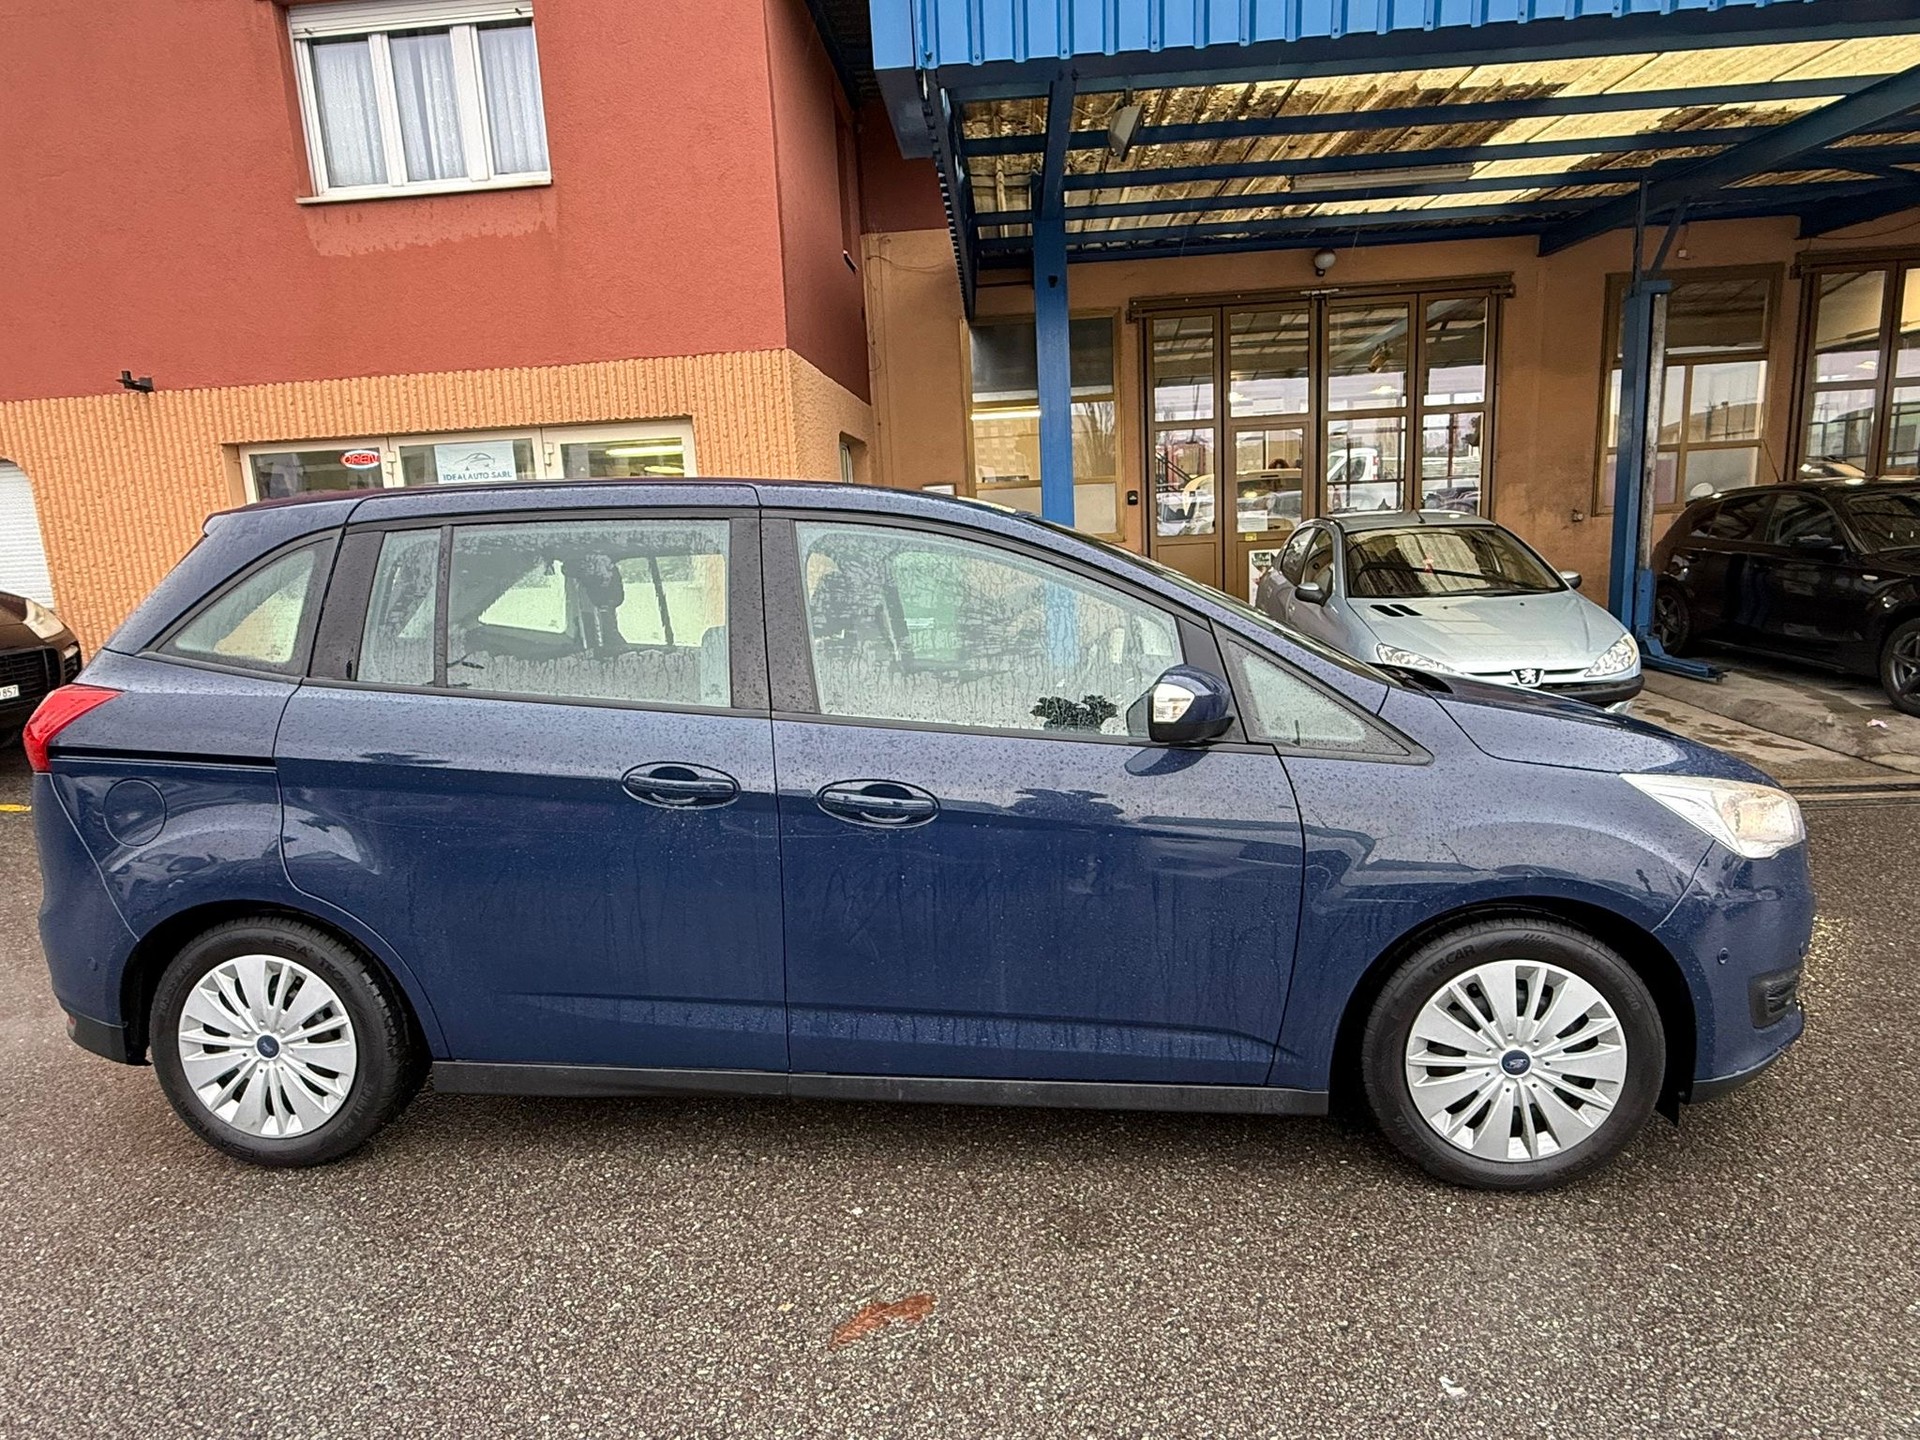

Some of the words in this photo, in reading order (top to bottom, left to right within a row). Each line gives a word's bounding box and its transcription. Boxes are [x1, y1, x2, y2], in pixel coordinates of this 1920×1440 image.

[342, 454, 378, 465] OPEN
[491, 470, 512, 479] SARL
[1426, 944, 1476, 974] TECAR
